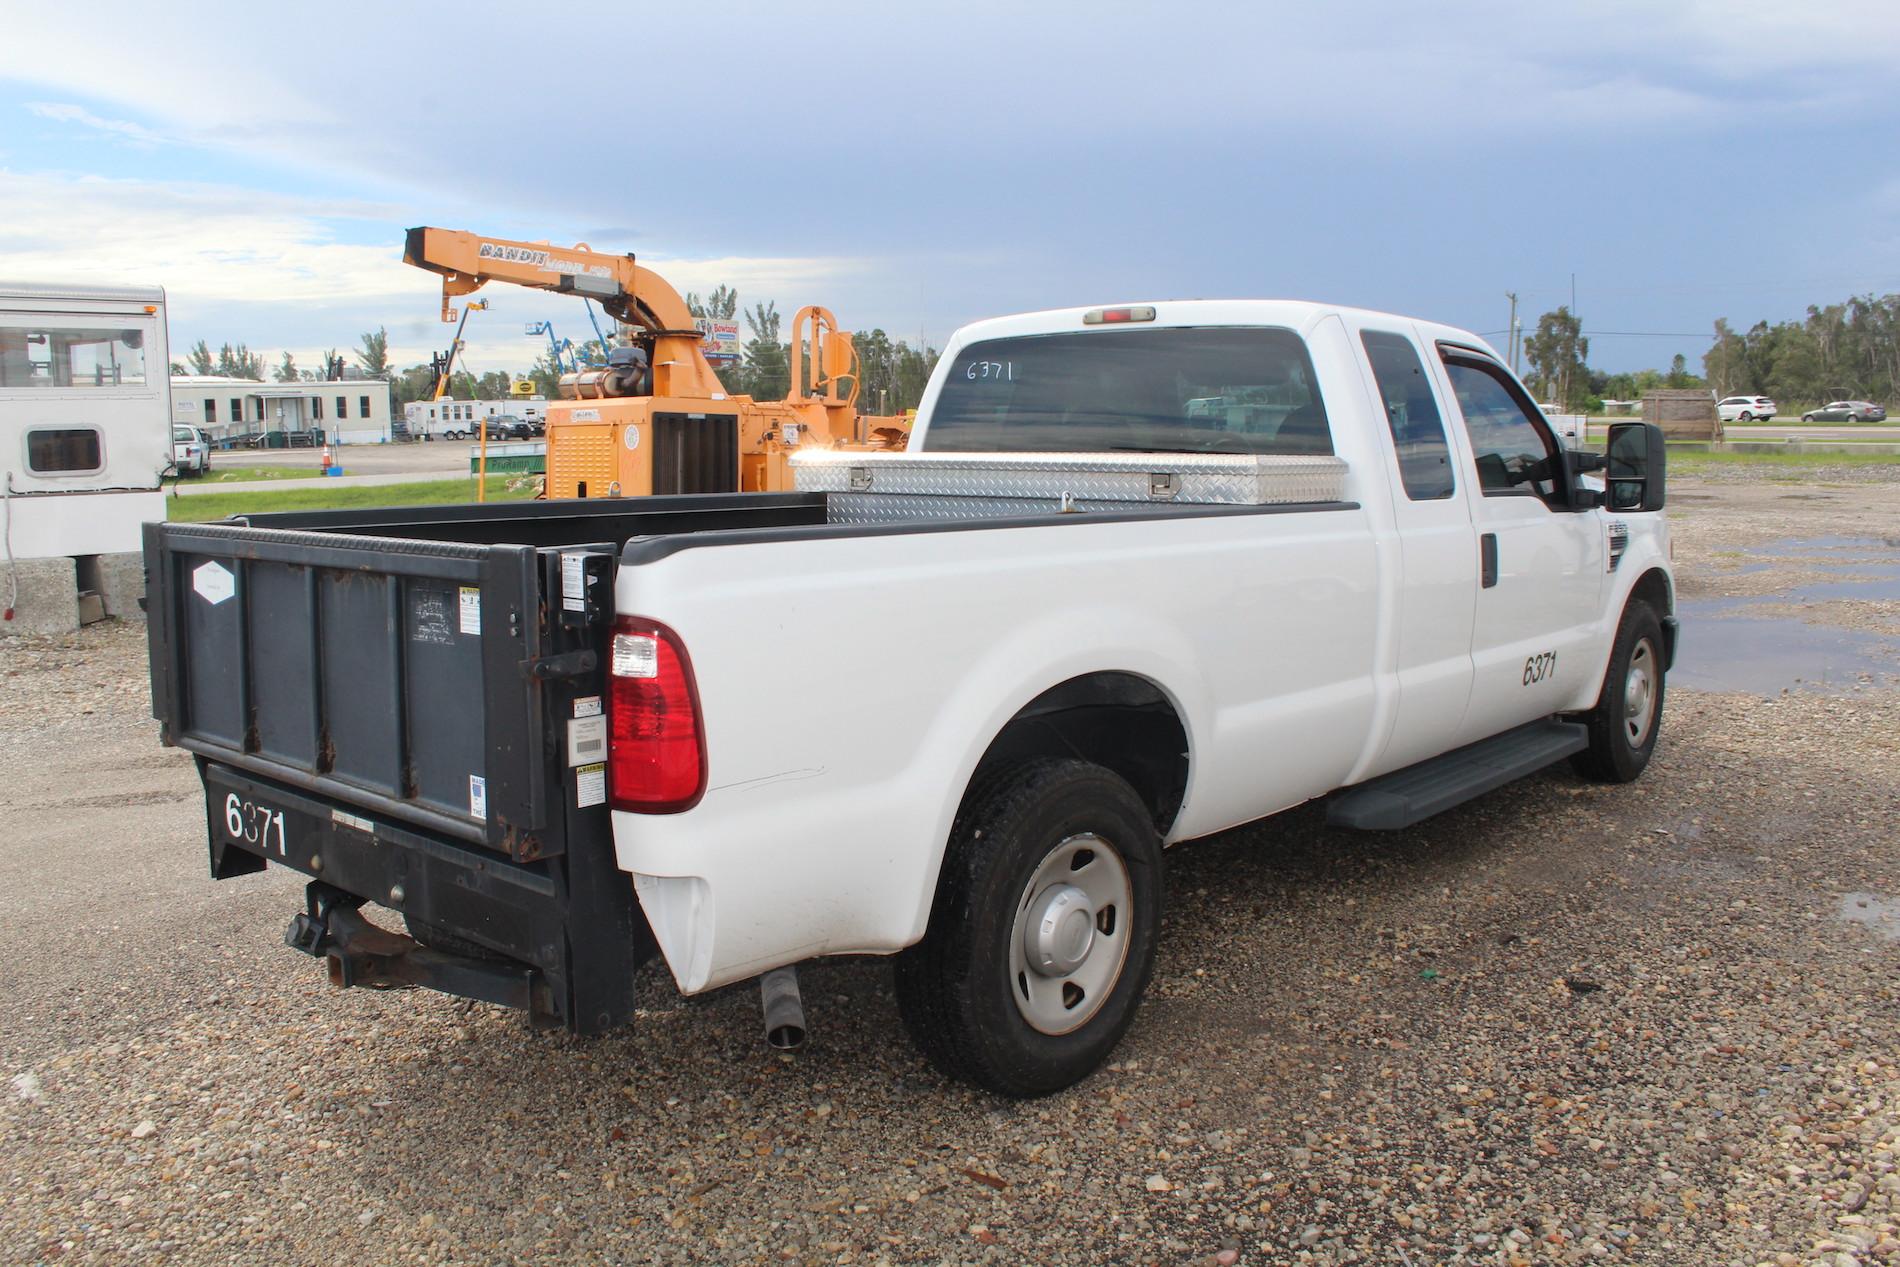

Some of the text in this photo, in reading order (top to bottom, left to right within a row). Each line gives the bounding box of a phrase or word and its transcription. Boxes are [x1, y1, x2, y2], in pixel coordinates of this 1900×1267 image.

[480, 243, 549, 265] BANDIT
[967, 361, 1012, 380] 6371
[1523, 650, 1557, 686] 6371
[226, 793, 286, 856] 6371
